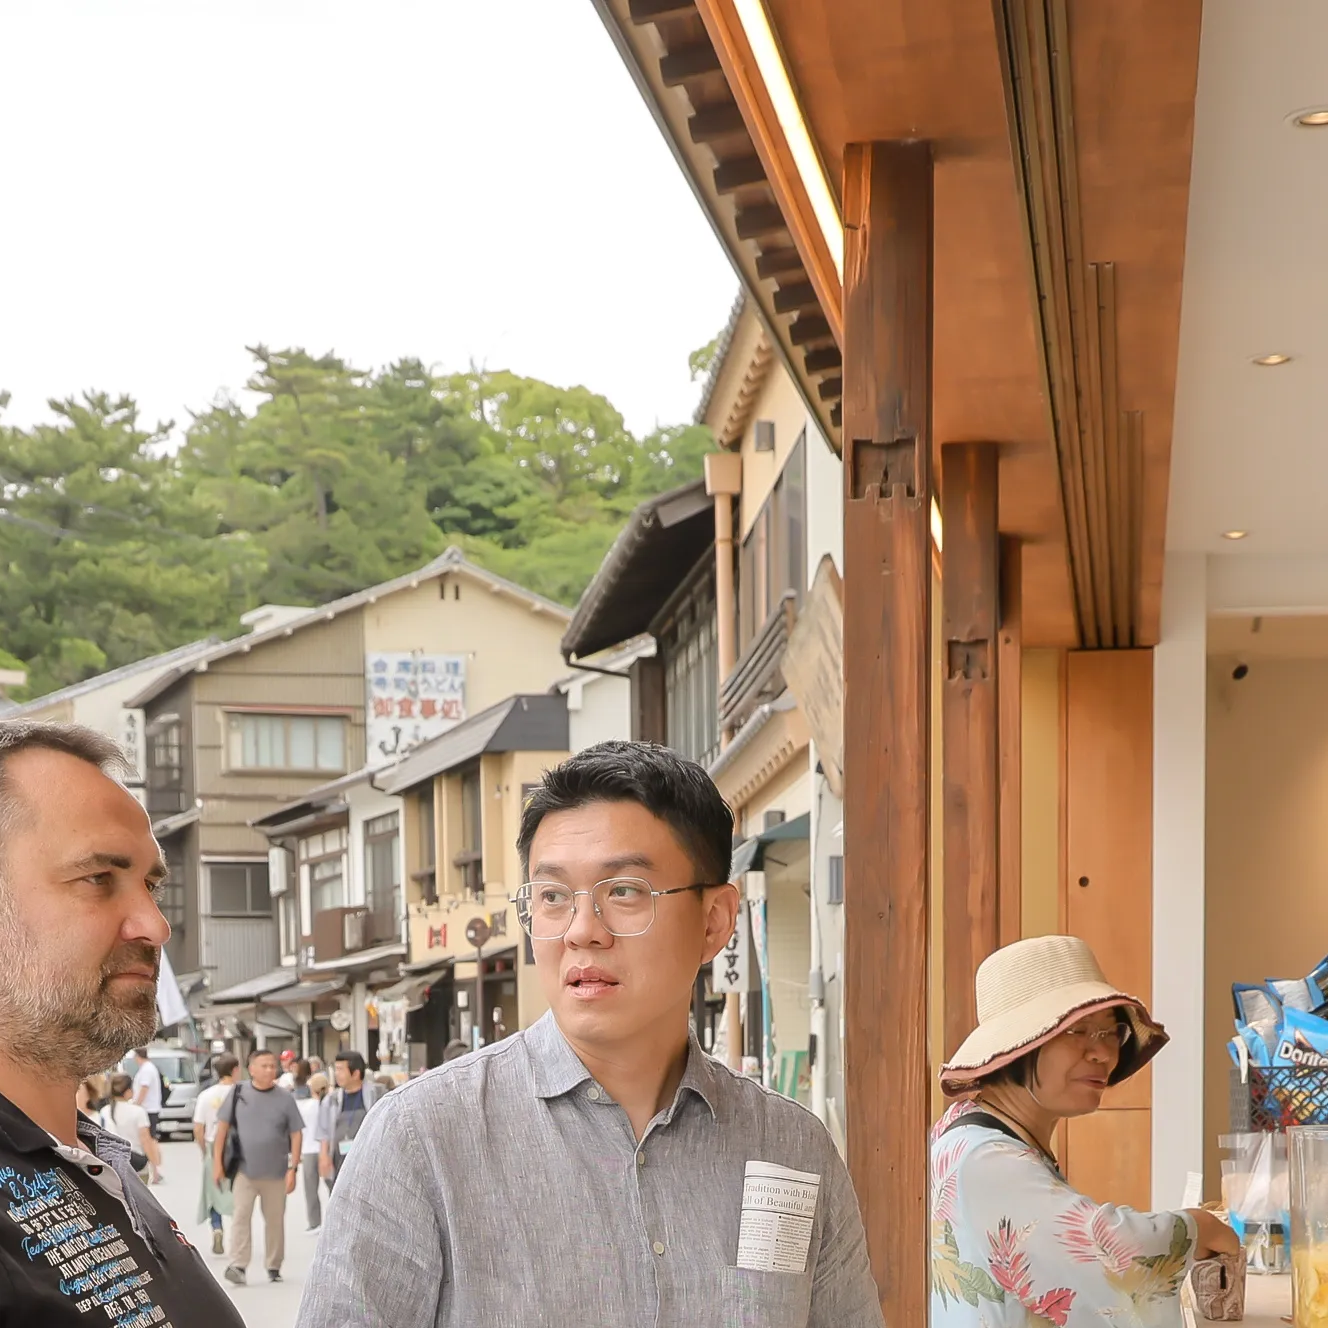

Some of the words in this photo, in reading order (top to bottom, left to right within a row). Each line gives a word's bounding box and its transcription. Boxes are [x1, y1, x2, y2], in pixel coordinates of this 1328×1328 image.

[372, 696, 459, 719] 御食事処
[745, 1183, 781, 1195] Tradition
[783, 1188, 800, 1198] with
[754, 1196, 764, 1205] of
[766, 1197, 804, 1210] Beautiful
[44, 1248, 64, 1266] THE
[58, 1250, 94, 1280] ATLANTIC
